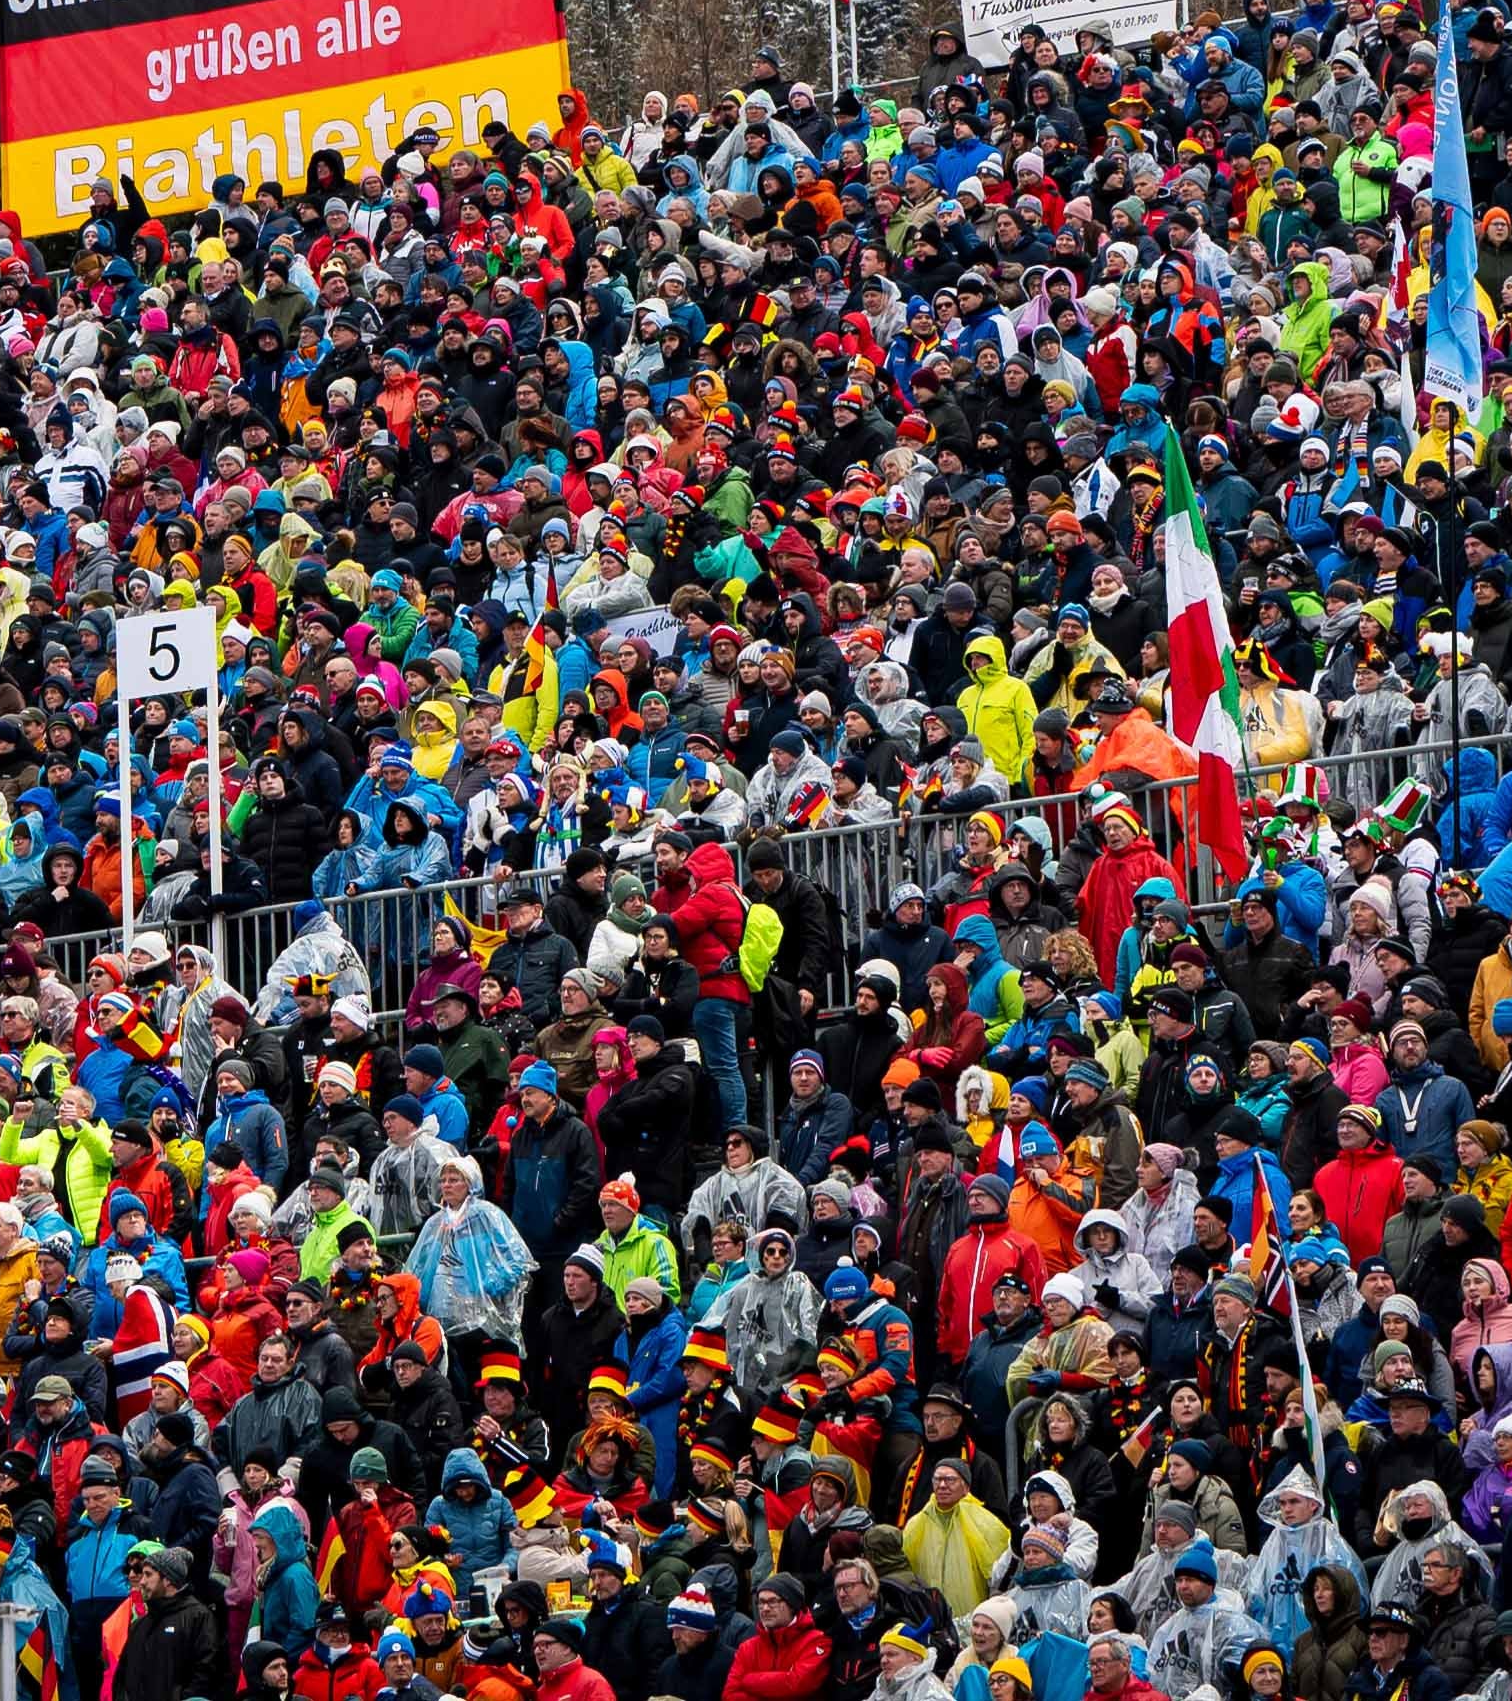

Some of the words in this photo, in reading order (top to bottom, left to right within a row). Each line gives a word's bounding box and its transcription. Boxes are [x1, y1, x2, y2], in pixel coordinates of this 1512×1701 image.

[146, 19, 302, 102] grüßen
[54, 87, 511, 218] Biathleten
[148, 625, 181, 681] 5
